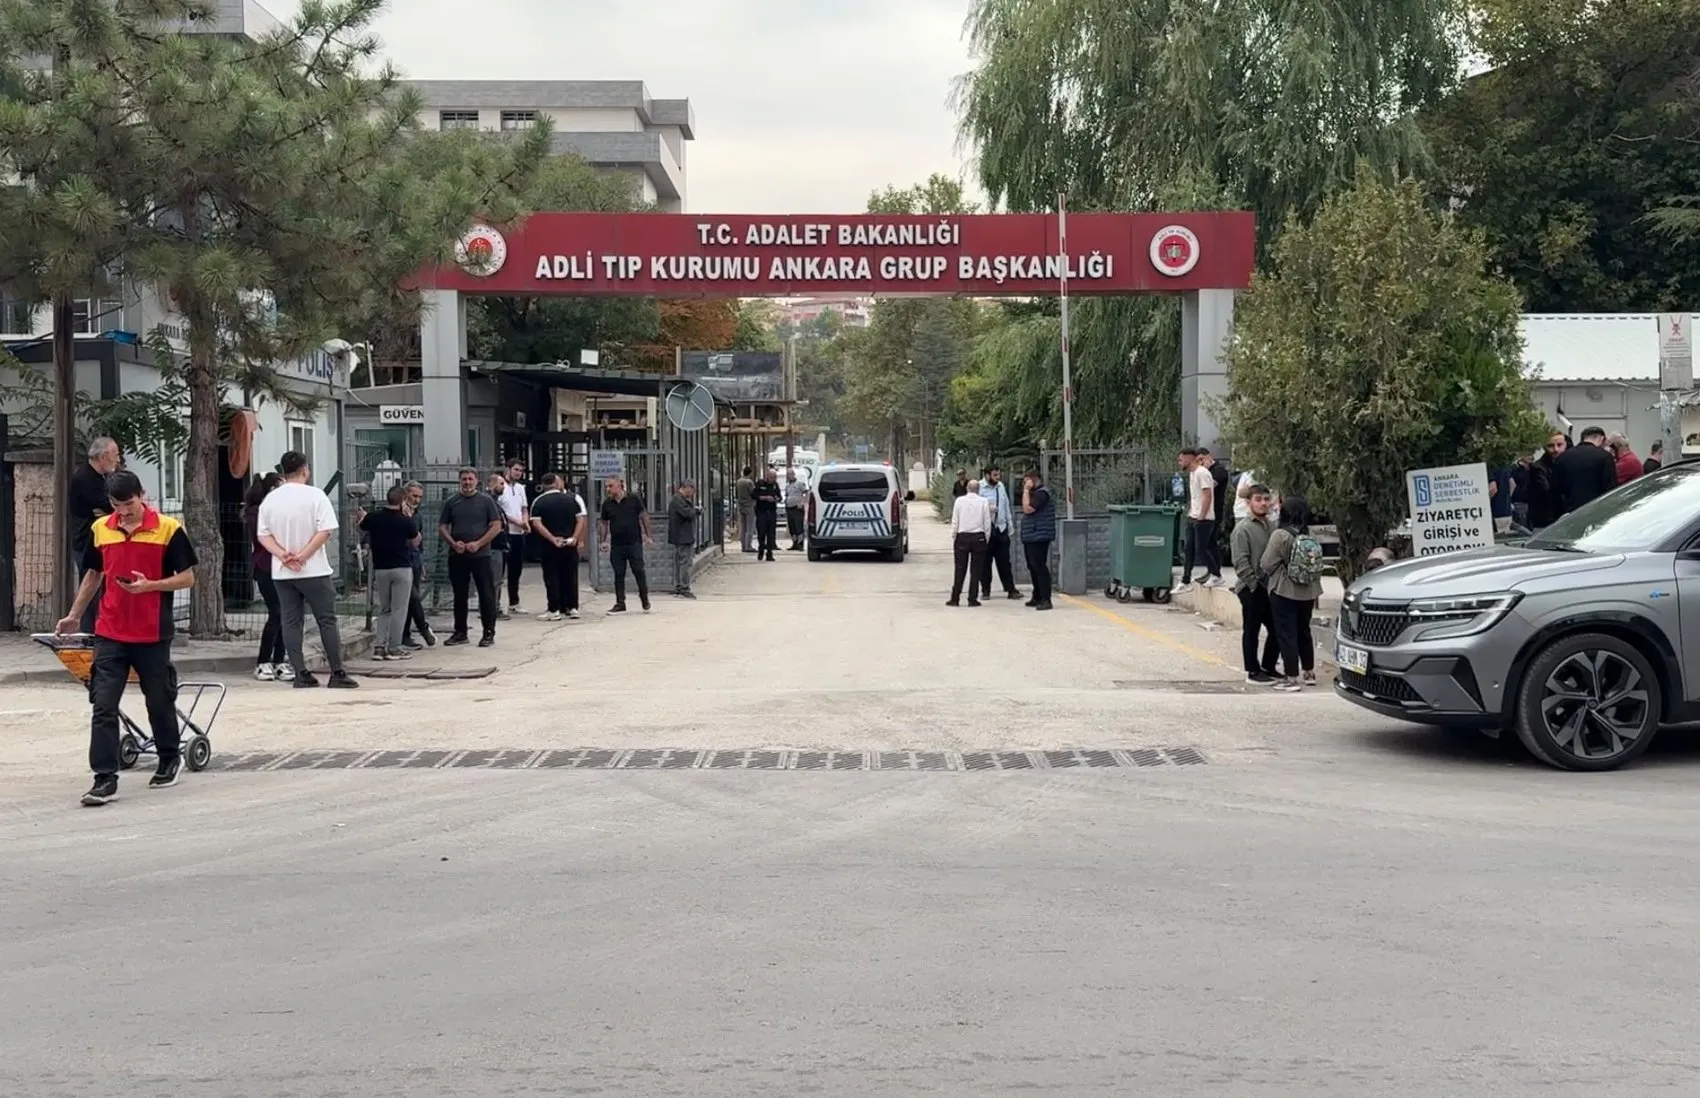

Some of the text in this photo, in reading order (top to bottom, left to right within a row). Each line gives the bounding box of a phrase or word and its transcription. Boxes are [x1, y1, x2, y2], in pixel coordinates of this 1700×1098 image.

[697, 219, 959, 245] T.C. ADALET BAKANLIĞI
[535, 249, 1113, 284] ADLİ TIP KURUMU ANKARA GRUP BAŞKANLIĞI
[1424, 524, 1480, 540] GİRİŞİ ve
